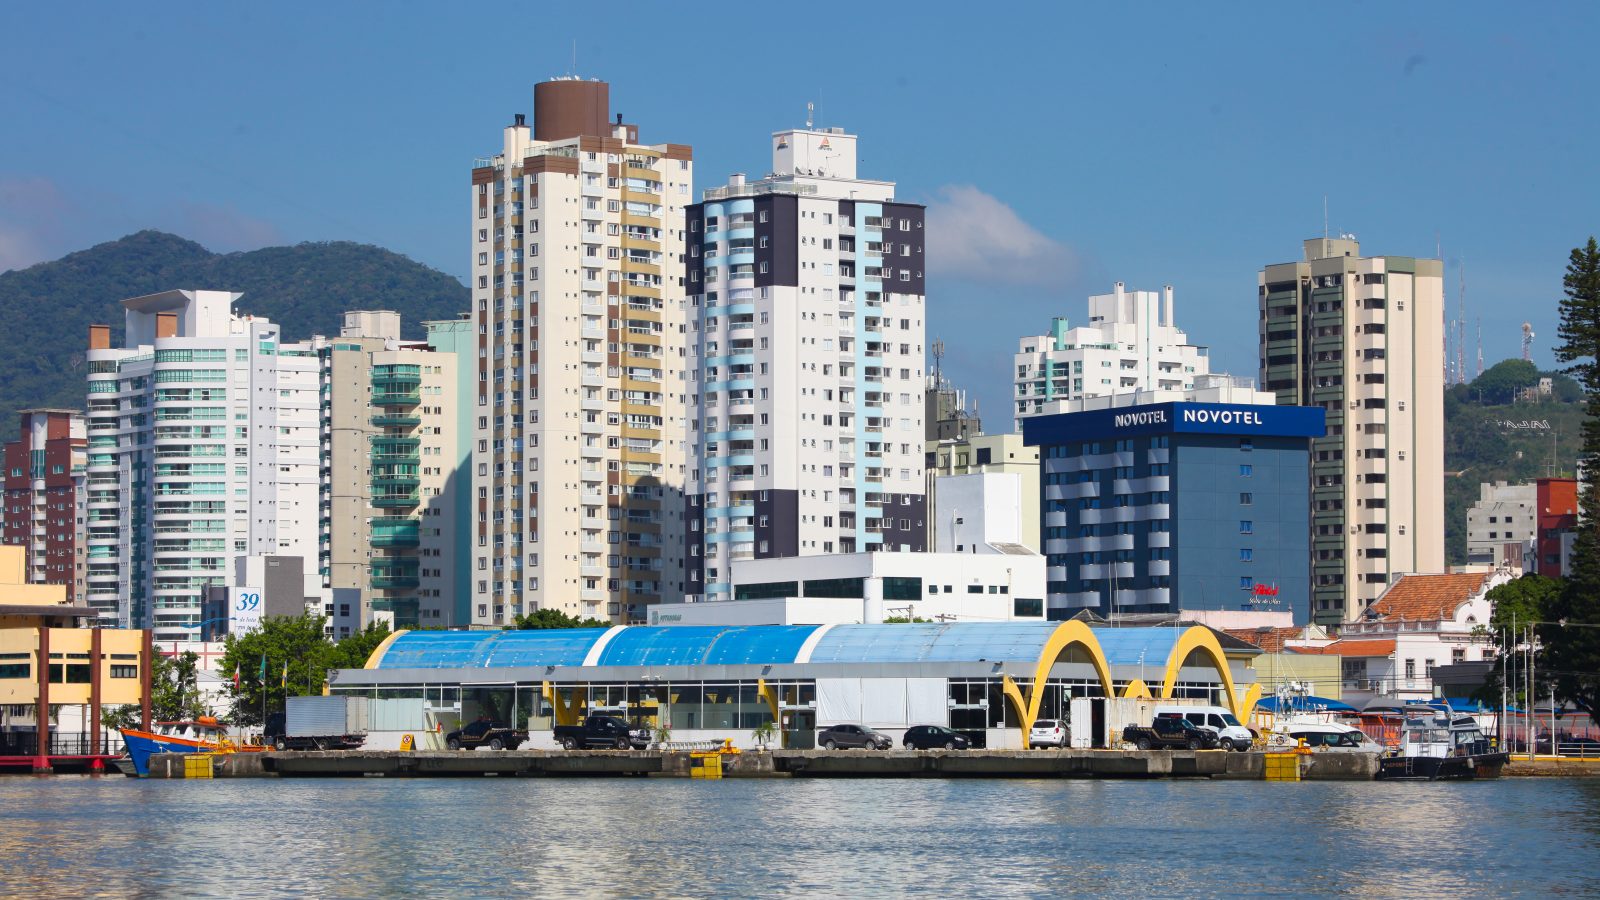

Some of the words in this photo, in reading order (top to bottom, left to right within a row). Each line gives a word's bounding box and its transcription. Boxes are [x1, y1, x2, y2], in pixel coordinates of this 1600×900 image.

[1115, 410, 1167, 428] NOVOTEL
[1183, 410, 1263, 425] NOVOTEL
[236, 593, 259, 611] 39
